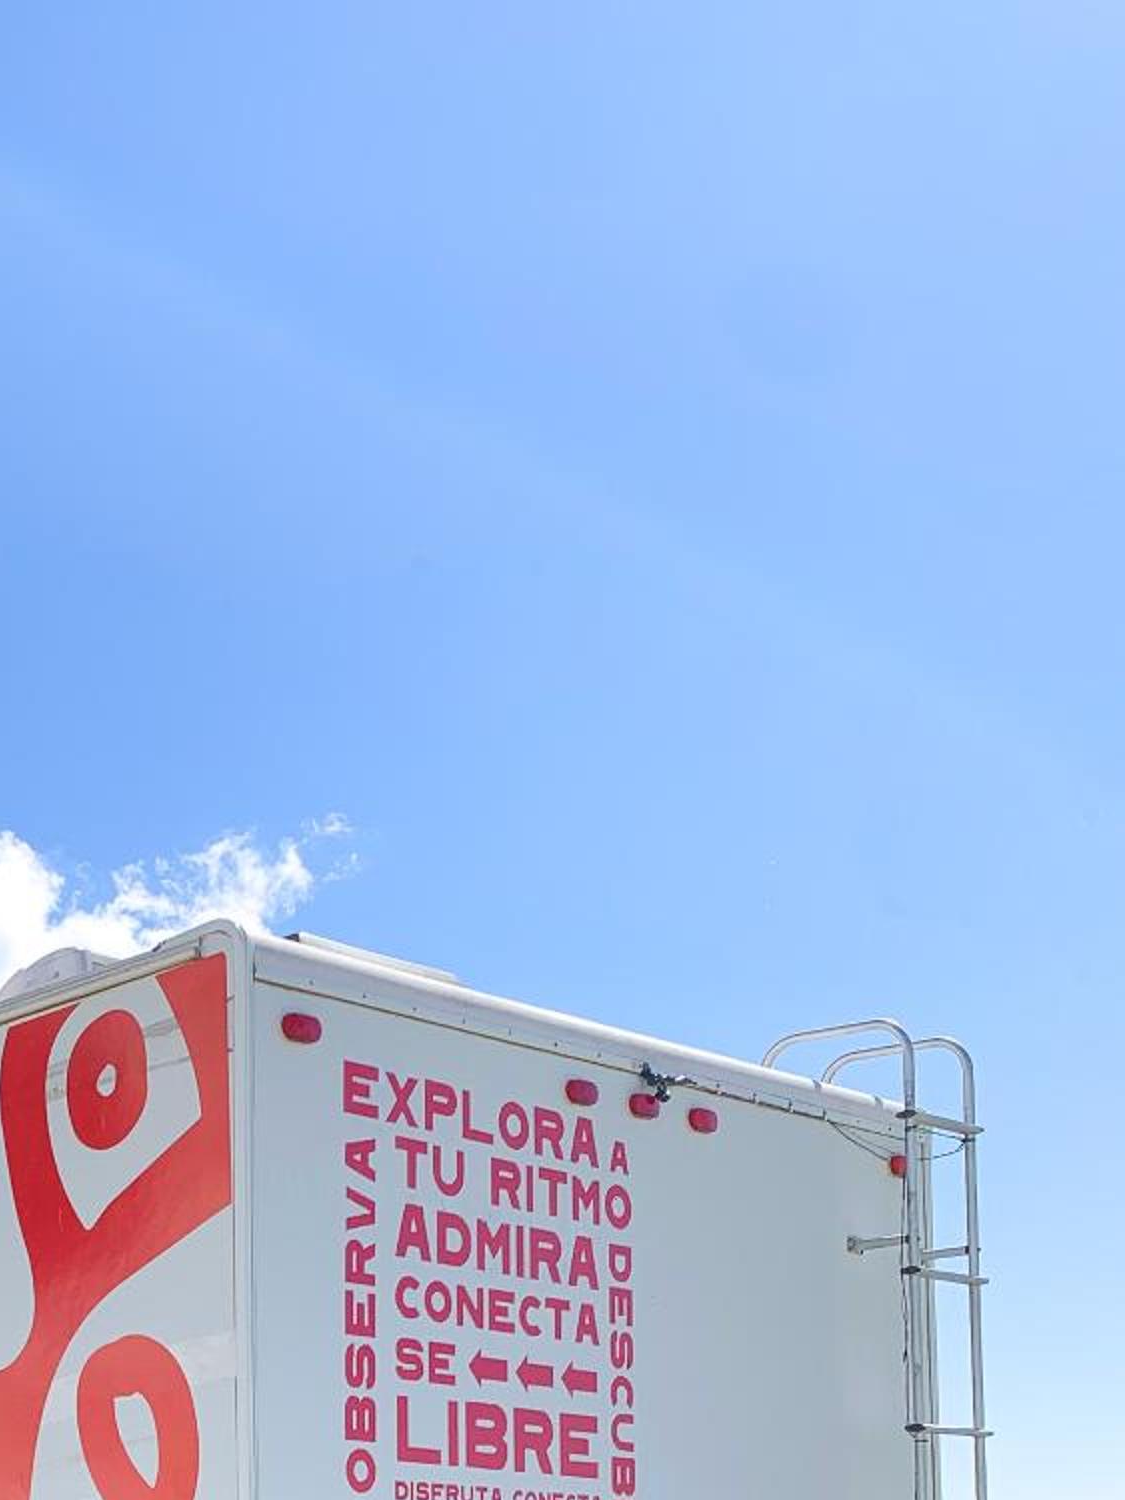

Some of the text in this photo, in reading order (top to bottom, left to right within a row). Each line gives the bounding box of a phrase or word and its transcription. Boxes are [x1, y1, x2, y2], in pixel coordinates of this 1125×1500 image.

[342, 1060, 629, 1175] EXPLORA A
[394, 1135, 632, 1229] TU RITMO
[394, 1204, 600, 1290] ADMIRA
[345, 1138, 376, 1493] OBSERVA
[394, 1275, 600, 1346] CONECTA
[395, 1337, 457, 1386] SE
[396, 1394, 599, 1479] LIBRE
